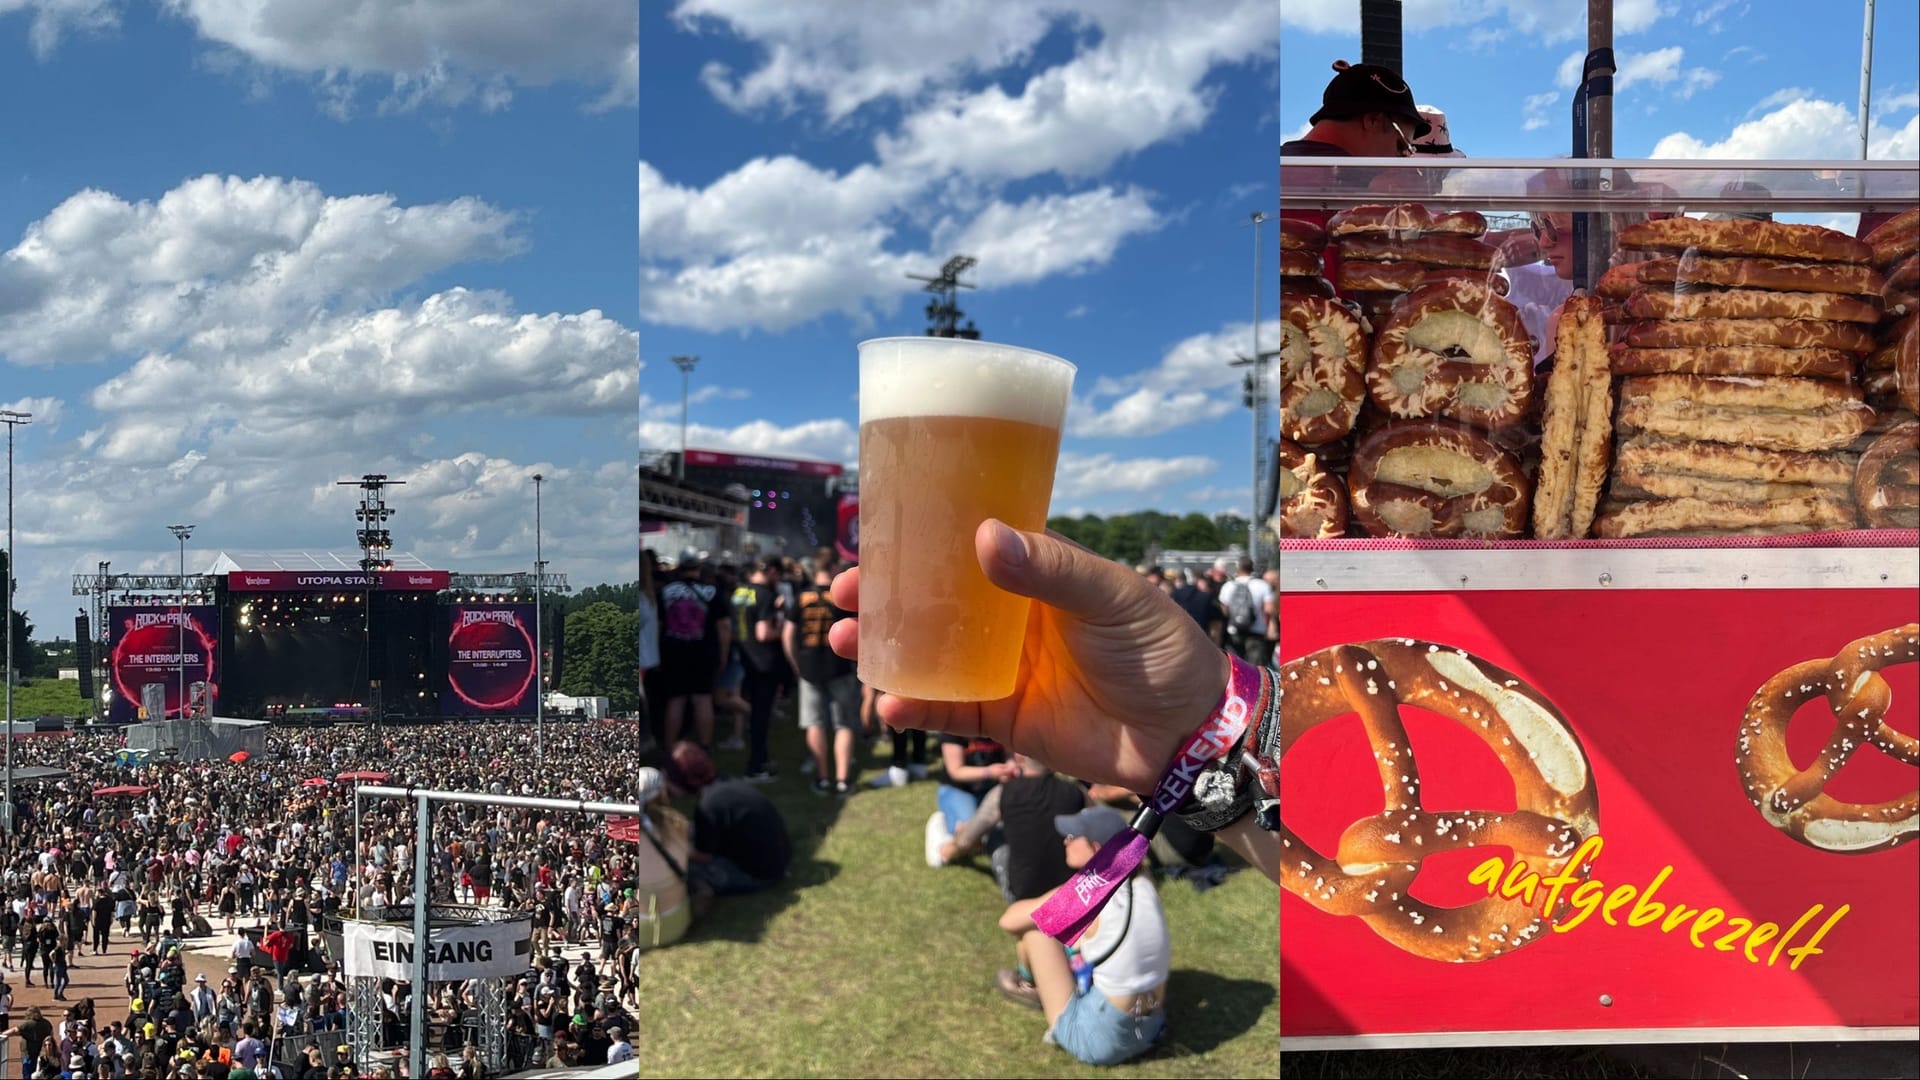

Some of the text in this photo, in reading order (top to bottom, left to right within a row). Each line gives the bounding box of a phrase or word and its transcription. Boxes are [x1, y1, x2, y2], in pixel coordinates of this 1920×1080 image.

[297, 576, 343, 585] UTOPIA
[135, 613, 160, 631] ROCK
[463, 611, 486, 628] ROCK
[492, 611, 516, 627] PARK
[129, 654, 199, 664] THE INTERRUPERS
[458, 650, 521, 659] THE INTERRUPTERS
[1075, 868, 1110, 906] PARK
[1467, 835, 1850, 971] aufgebrezelt
